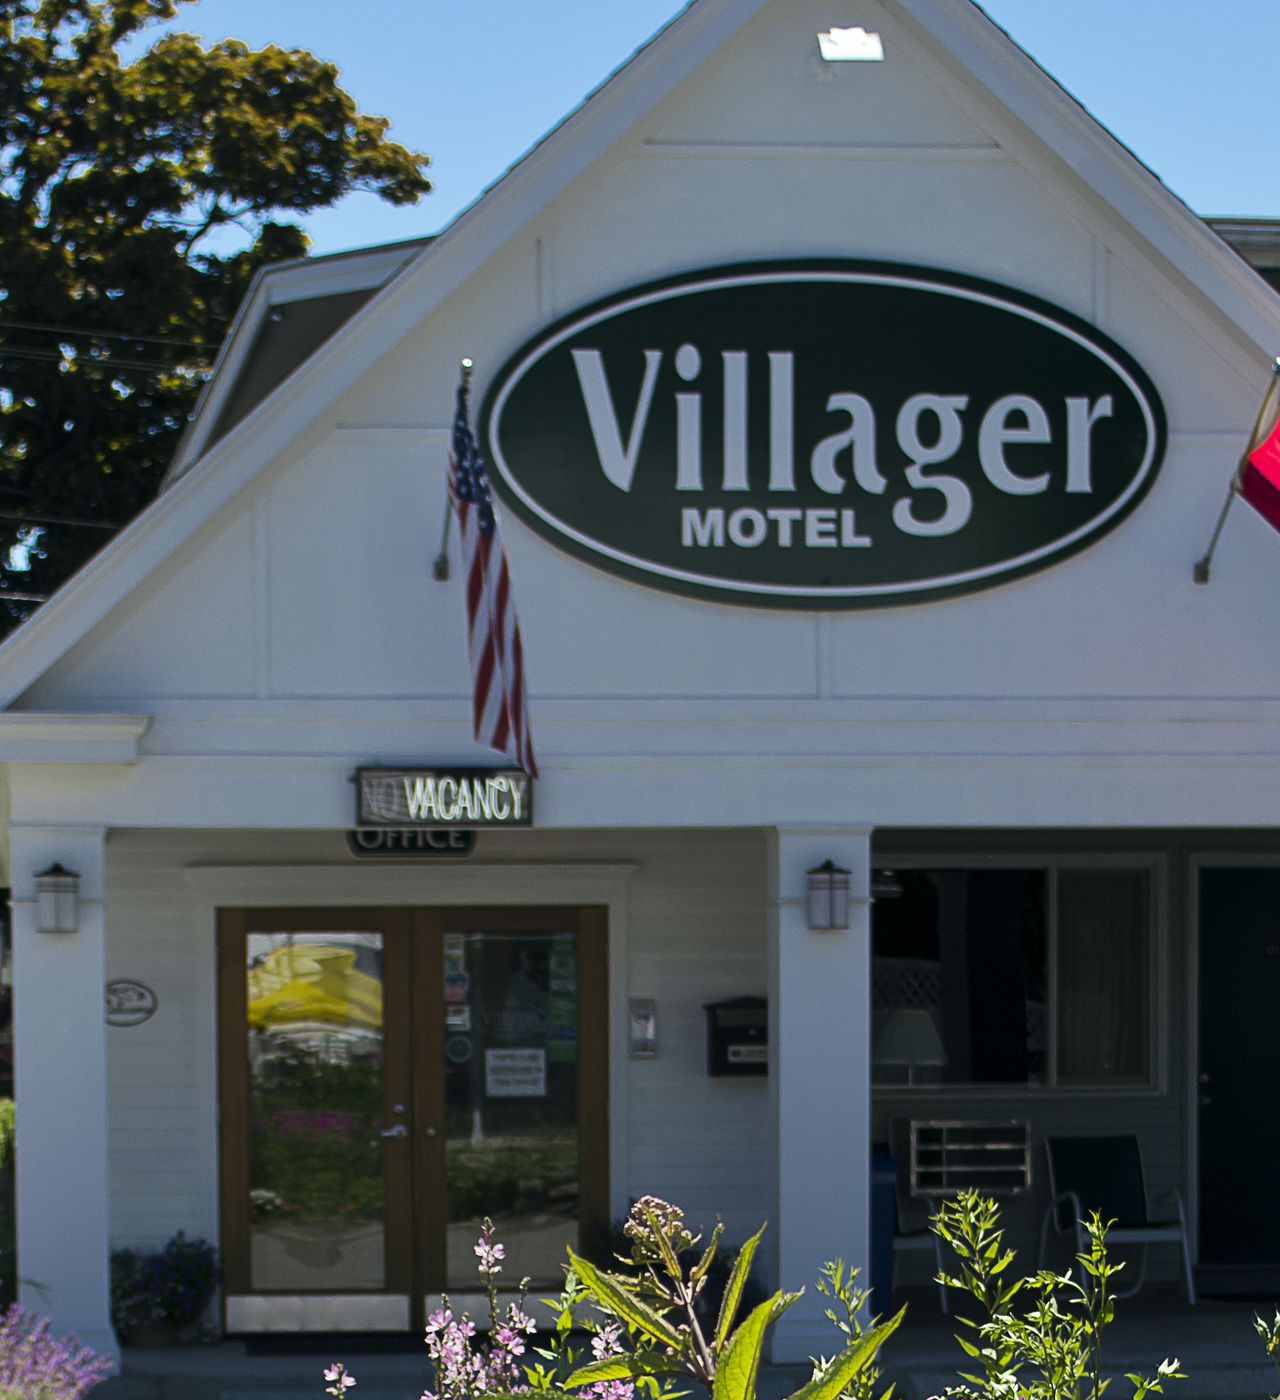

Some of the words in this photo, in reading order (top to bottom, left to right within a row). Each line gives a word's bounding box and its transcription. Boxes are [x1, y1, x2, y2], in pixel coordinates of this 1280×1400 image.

[570, 343, 1112, 537] Villager
[681, 508, 872, 549] MOTEL
[361, 779, 401, 818] NO
[403, 776, 526, 821] VACANCY
[356, 829, 466, 849] OFFICE
